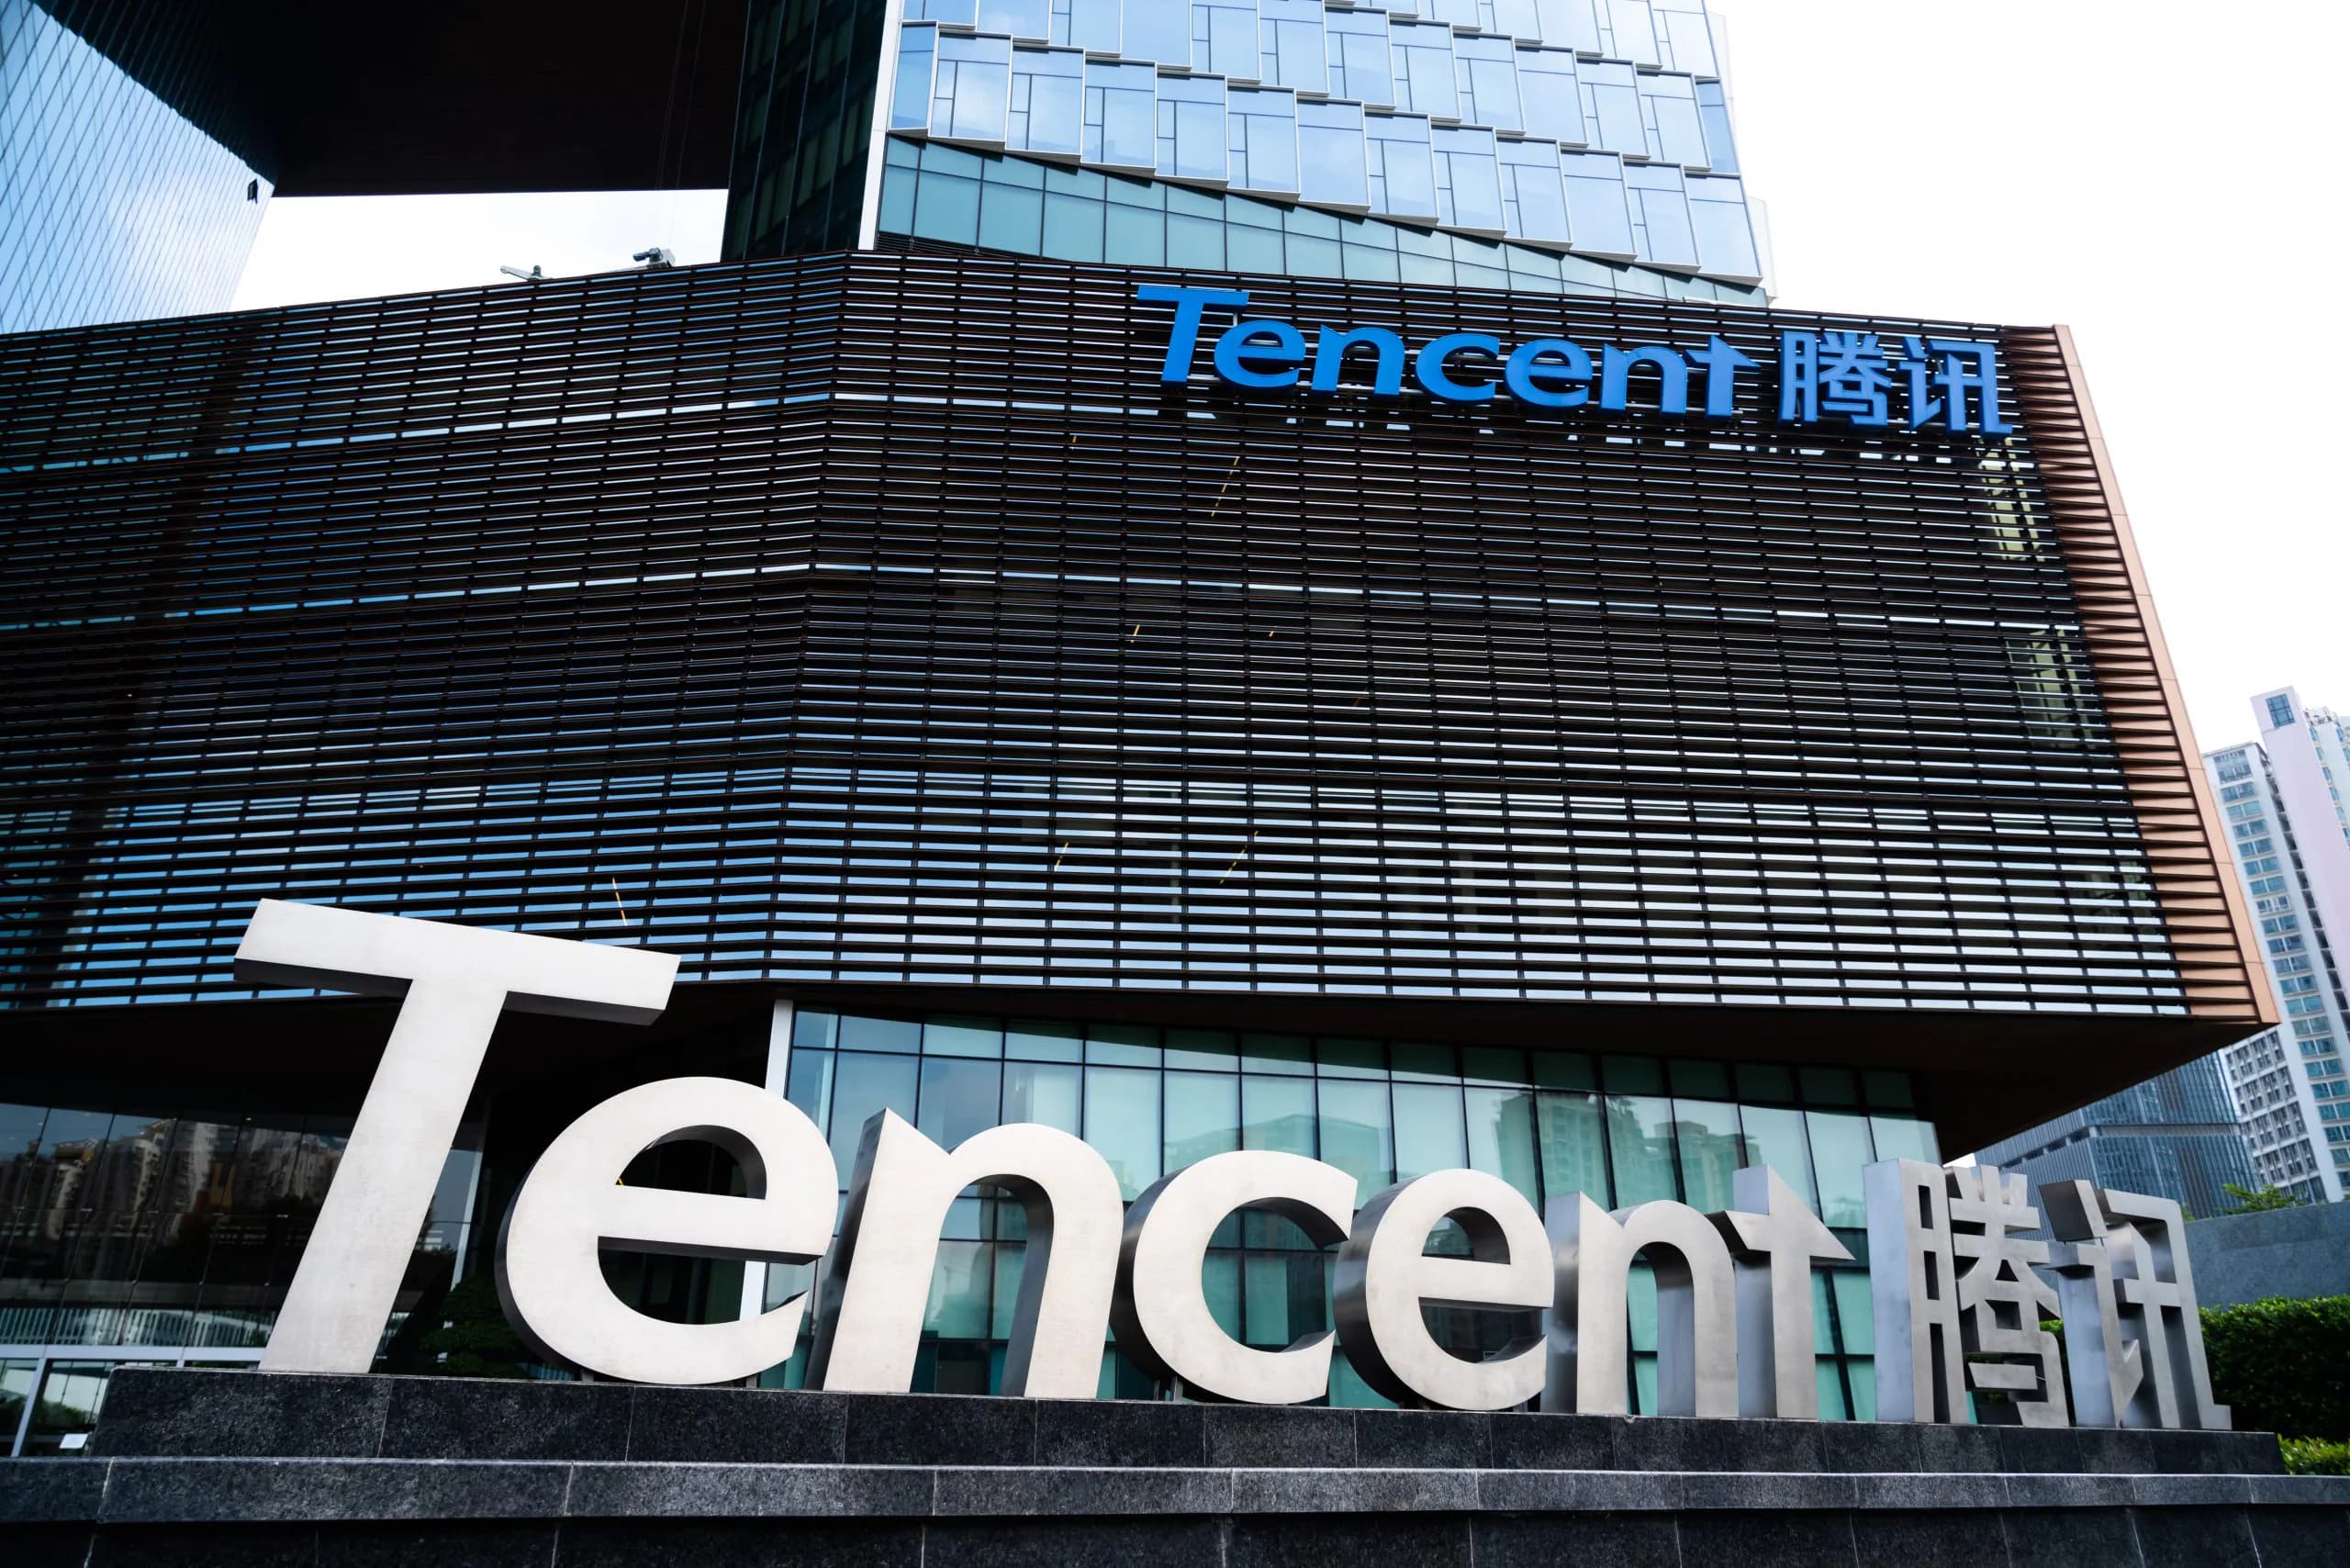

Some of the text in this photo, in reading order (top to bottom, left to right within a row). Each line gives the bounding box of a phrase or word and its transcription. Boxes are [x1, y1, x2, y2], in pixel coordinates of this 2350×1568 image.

[1137, 284, 2014, 436] Tencent 腾讯
[234, 898, 2232, 1431] Tencent 腾讯
